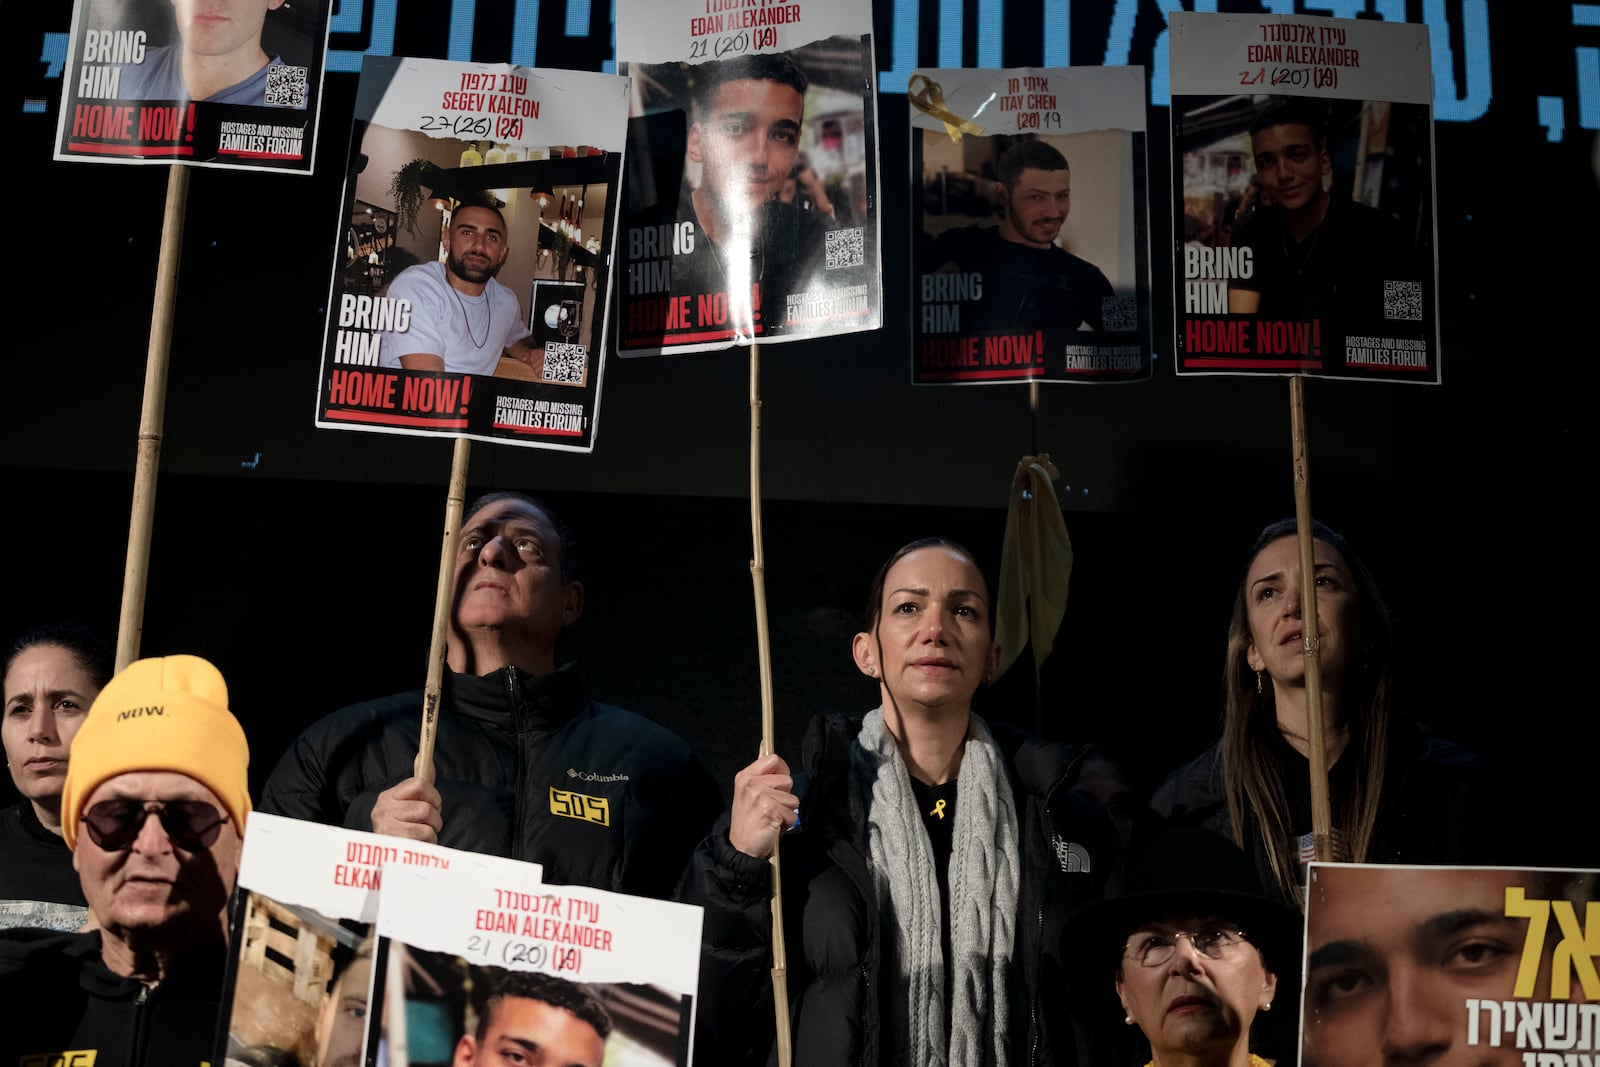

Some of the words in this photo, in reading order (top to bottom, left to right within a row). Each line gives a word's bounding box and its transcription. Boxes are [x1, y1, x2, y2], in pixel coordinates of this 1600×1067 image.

[691, 15, 723, 36] EDAN
[727, 4, 800, 31] ALEXANDER
[83, 29, 147, 64] BRING
[690, 39, 708, 59] 21
[753, 27, 778, 50] (19)
[1260, 24, 1315, 44] אלכסנדר
[1319, 27, 1346, 46] עידן
[1248, 45, 1282, 62] EDAN
[1286, 46, 1360, 67] ALEXANDER
[78, 66, 120, 99] HIM
[460, 73, 496, 91] כלפון
[499, 74, 527, 95] שגב
[1008, 78, 1020, 95] חן
[1024, 76, 1048, 92] איתי
[1270, 67, 1310, 88] (20)
[442, 92, 485, 112] SEGEV
[488, 95, 540, 119] KALFON
[1000, 95, 1024, 112] ITAY
[1028, 94, 1056, 110] CHEN
[72, 104, 134, 139] HOME
[139, 103, 196, 142] NOW!
[221, 122, 256, 136] HOSTAGES
[257, 125, 271, 138] AND
[272, 126, 304, 139] MISSING
[1044, 112, 1061, 128] 19
[219, 133, 264, 152] FAMILIES
[266, 138, 302, 155] FORUM
[628, 221, 694, 260] BRING
[1184, 246, 1253, 279] BRING
[628, 260, 670, 295] HIM
[921, 272, 982, 303] BRING
[1185, 280, 1228, 314] HIM
[338, 293, 411, 333] BRING
[628, 296, 691, 334] HOME
[921, 304, 960, 334] HIM
[334, 330, 381, 367] HIM
[921, 337, 979, 368] HOME
[984, 330, 1044, 366] NOW!
[1186, 320, 1250, 354] HOME
[1257, 318, 1321, 356] NOW!
[1346, 336, 1380, 348] HOSTAGES
[1381, 338, 1395, 349] AND
[1396, 338, 1426, 351] MISSING
[1066, 354, 1108, 370] FAMILIES
[1109, 356, 1141, 369] FORUM
[1346, 348, 1389, 365] FAMILIES
[1392, 350, 1426, 368] FORUM
[330, 370, 398, 408] HOME
[402, 376, 471, 415] NOW!
[497, 396, 533, 410] HOSTAGES
[534, 399, 549, 412] AND
[550, 400, 583, 416] MISSING
[494, 407, 542, 428] FAMILIES
[544, 412, 581, 432] FORUM
[578, 772, 629, 782] Columbia
[494, 888, 562, 916] אלכסנדר
[568, 897, 599, 924] עידן
[476, 909, 517, 935] EDAN
[522, 916, 612, 952] ALEXANDER
[468, 936, 491, 956] 21
